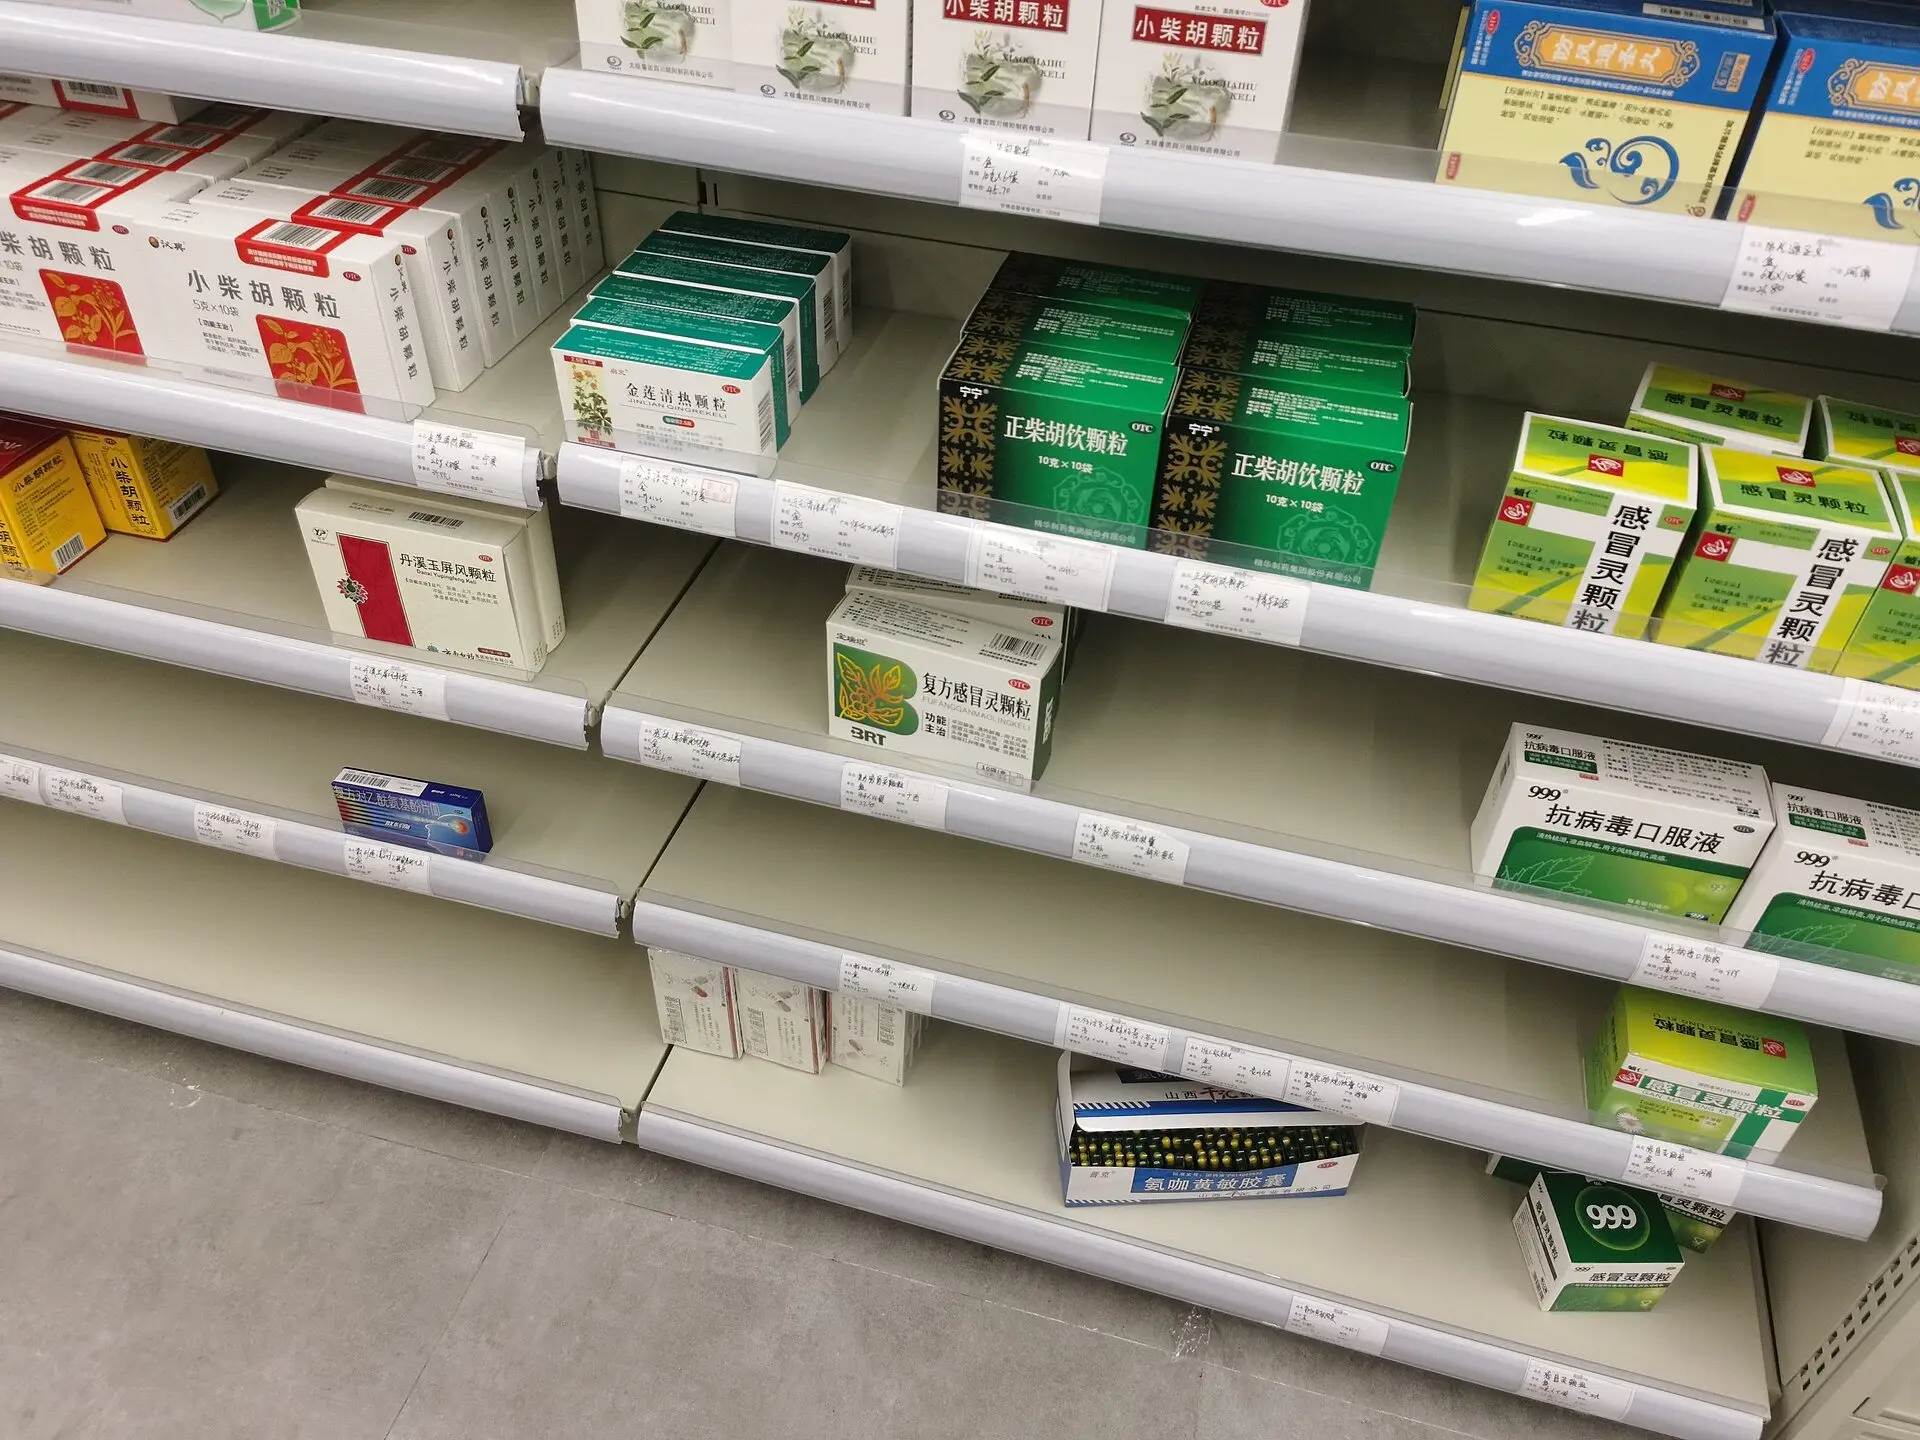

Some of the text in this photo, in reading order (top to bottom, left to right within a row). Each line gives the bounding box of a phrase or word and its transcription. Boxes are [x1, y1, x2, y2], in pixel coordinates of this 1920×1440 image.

[946, 0, 1064, 28] 小柴胡颗粒
[816, 29, 876, 44] XIAOCHAIHU
[1135, 14, 1260, 50] 小柴胡颗粒
[853, 46, 877, 55] KELI
[1002, 52, 1065, 67] XIAOCHAIHU
[1551, 33, 1661, 75] 防风通圣丸
[1040, 70, 1065, 79] KELI
[1191, 75, 1257, 91] XIAOCHAIHU
[1230, 93, 1257, 102] KELI
[553, 180, 572, 264] 小柴胡颗粒
[528, 199, 549, 284] 小柴胡颗粒
[503, 218, 525, 306] 小柴胡颗粒
[188, 269, 341, 319] 小柴胡颗粒
[476, 238, 500, 327] 小柴胡颗粒
[443, 261, 469, 350] 小柴胡颗粒
[390, 287, 418, 379] 小柴胡颗粒
[626, 382, 727, 412] 金莲清热颗粒
[723, 385, 740, 394] OTC
[628, 398, 728, 419] JINLIAN QINGREKELI
[1664, 392, 1783, 427] 感冒灵颗粒
[1003, 415, 1128, 458] 正柴胡饮颗粒
[1131, 422, 1154, 433] OTC
[1547, 428, 1669, 462] 感冒灵颗粒
[13, 453, 64, 494] 小柴胡颗粒
[1231, 452, 1366, 496] 正柴胡饮颗粒
[1370, 461, 1395, 472] OTC
[111, 456, 149, 526] 小柴胡颗粒
[1741, 483, 1869, 516] 感冒灵颗粒
[399, 553, 497, 583] 丹溪玉屏风颗粒
[1571, 504, 1652, 634] 感冒灵颗粒
[1765, 537, 1859, 668] 感冒灵颗粒
[1033, 616, 1053, 627] OTC
[922, 672, 1032, 722] 复方感冒灵颗粒
[1010, 680, 1030, 690] OTC
[924, 723, 947, 738] 主治
[925, 711, 947, 727] 功能
[850, 726, 887, 746] BRT
[1524, 739, 1597, 760] 抗病毒口服液
[1527, 785, 1561, 802] 999
[1787, 802, 1862, 825] 抗病毒口服液
[1545, 803, 1725, 855] 抗病毒口服液
[1793, 850, 1830, 868] 999
[1653, 1017, 1760, 1051] 感冒灵颗粒
[1642, 1090, 1663, 1100] GAN
[1666, 1095, 1690, 1106] MAO
[1692, 1102, 1716, 1112] LING
[1718, 1108, 1733, 1116] KE
[1645, 1078, 1784, 1119] 感冒灵颗粒
[1144, 1172, 1287, 1192] 氨咖黄敏胶囊
[1586, 1204, 1637, 1230] 999
[1588, 1272, 1673, 1282] 感冒灵颗粒
